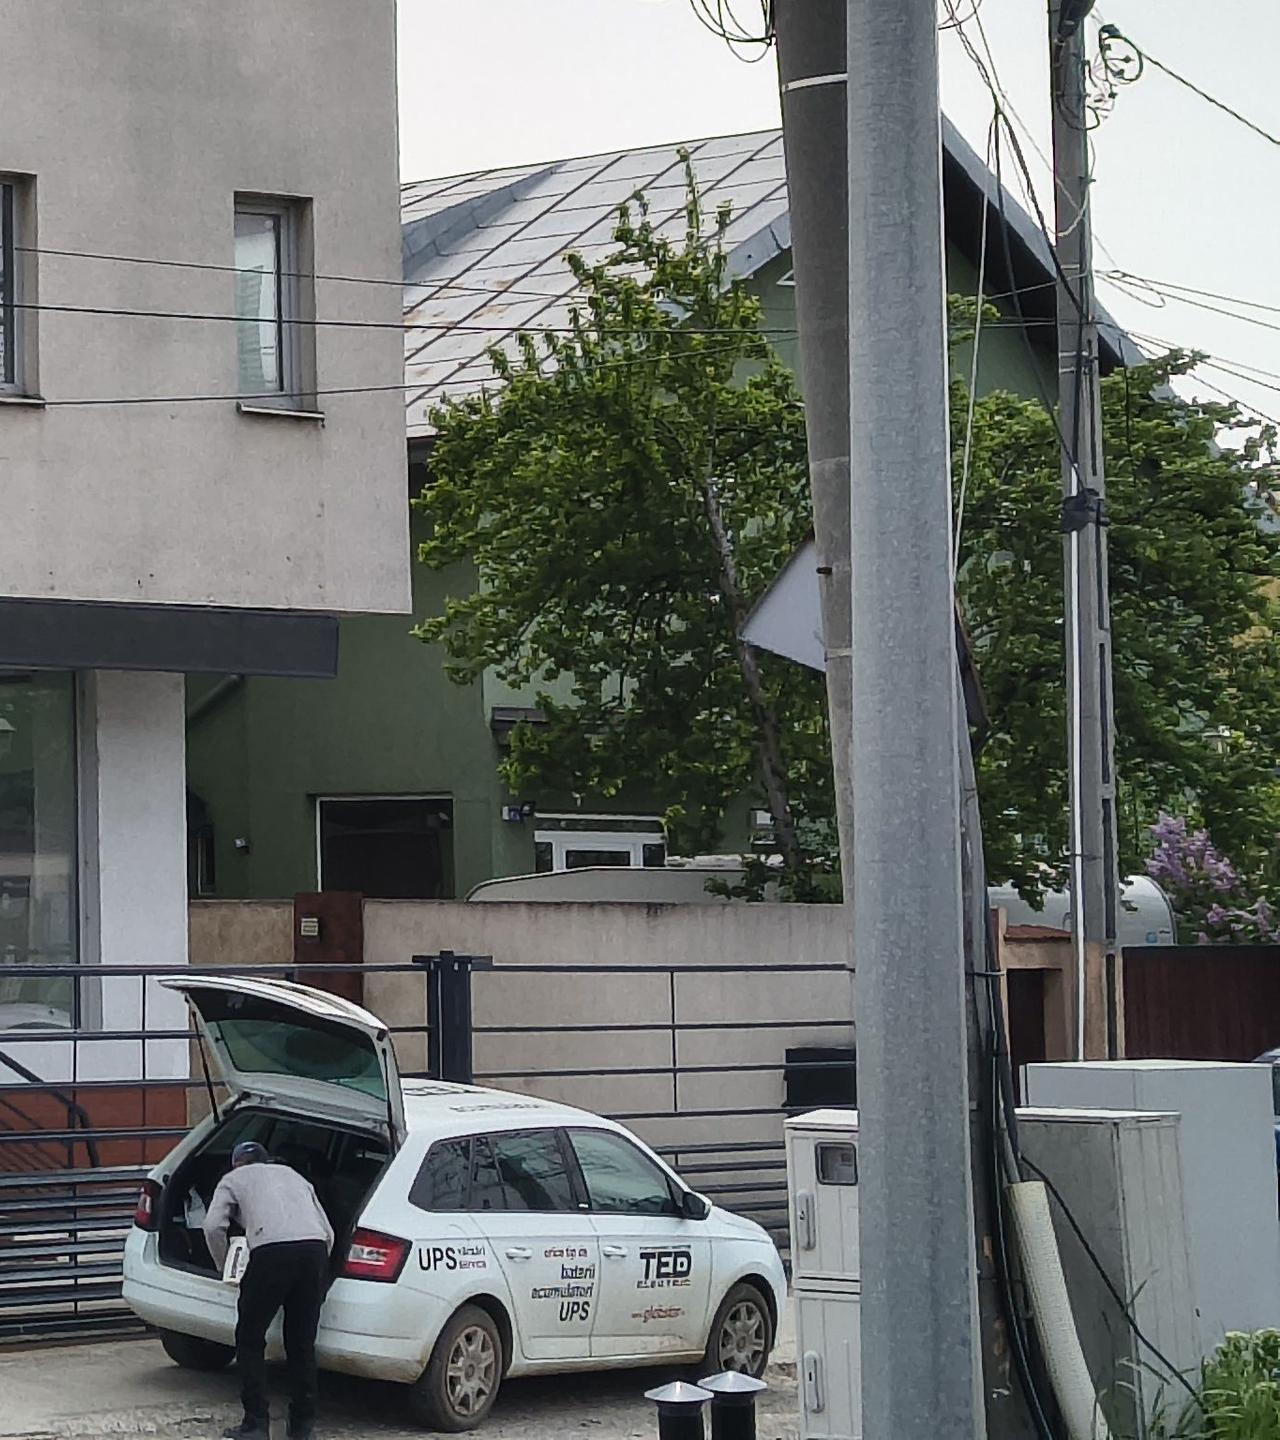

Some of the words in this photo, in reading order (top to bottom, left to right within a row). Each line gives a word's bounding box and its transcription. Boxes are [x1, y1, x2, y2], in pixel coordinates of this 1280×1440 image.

[418, 1246, 458, 1271] UPS
[640, 1251, 691, 1280] TED
[559, 1301, 590, 1322] UPS
